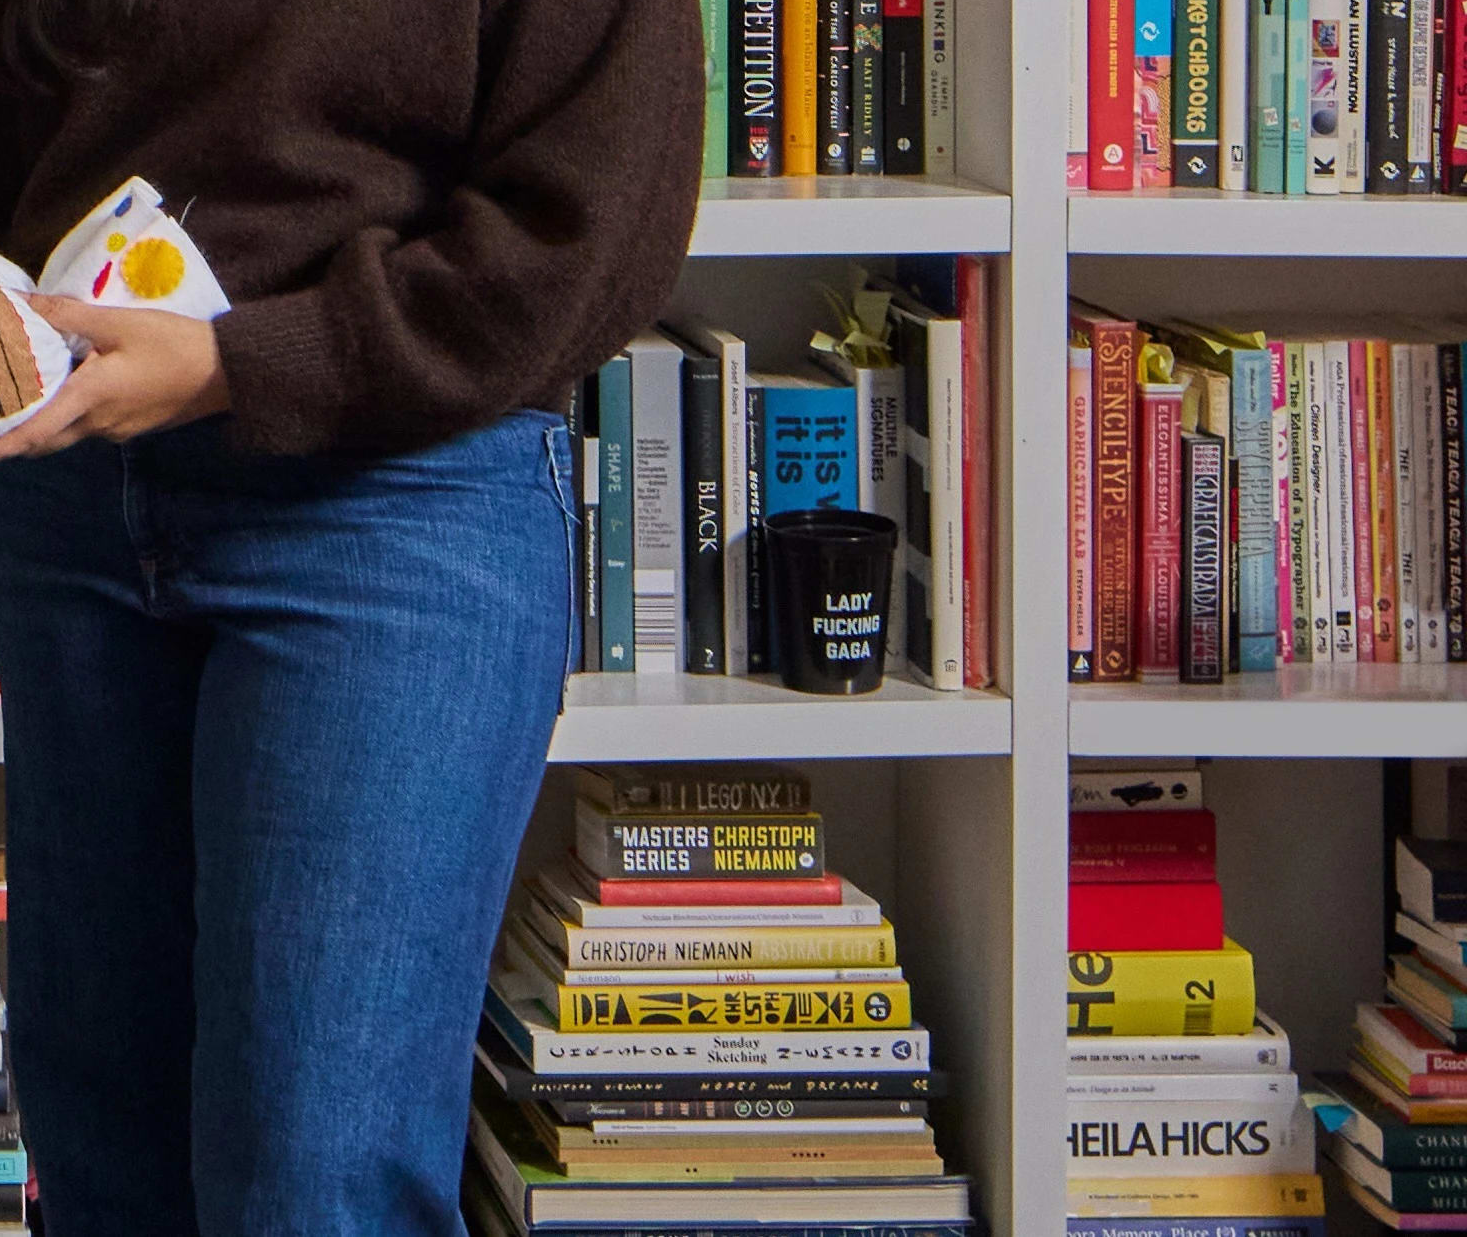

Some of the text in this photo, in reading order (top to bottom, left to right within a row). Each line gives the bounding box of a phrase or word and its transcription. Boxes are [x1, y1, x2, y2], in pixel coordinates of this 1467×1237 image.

[1073, 396, 1086, 559] GRAPHIC STYLE LAB
[698, 481, 718, 553] BLACK
[826, 593, 872, 612] LADY
[813, 614, 880, 635] FUCKING
[826, 641, 871, 659] GAGA
[622, 826, 816, 847] MASTERS CHRISTOPH
[623, 850, 796, 871] SERIES NIEMANN
[580, 939, 753, 962] CHRISTOPH NIEMANN
[713, 1036, 760, 1051] Sunday
[707, 1050, 767, 1064] Sketching
[1162, 1121, 1271, 1157] HICKS
